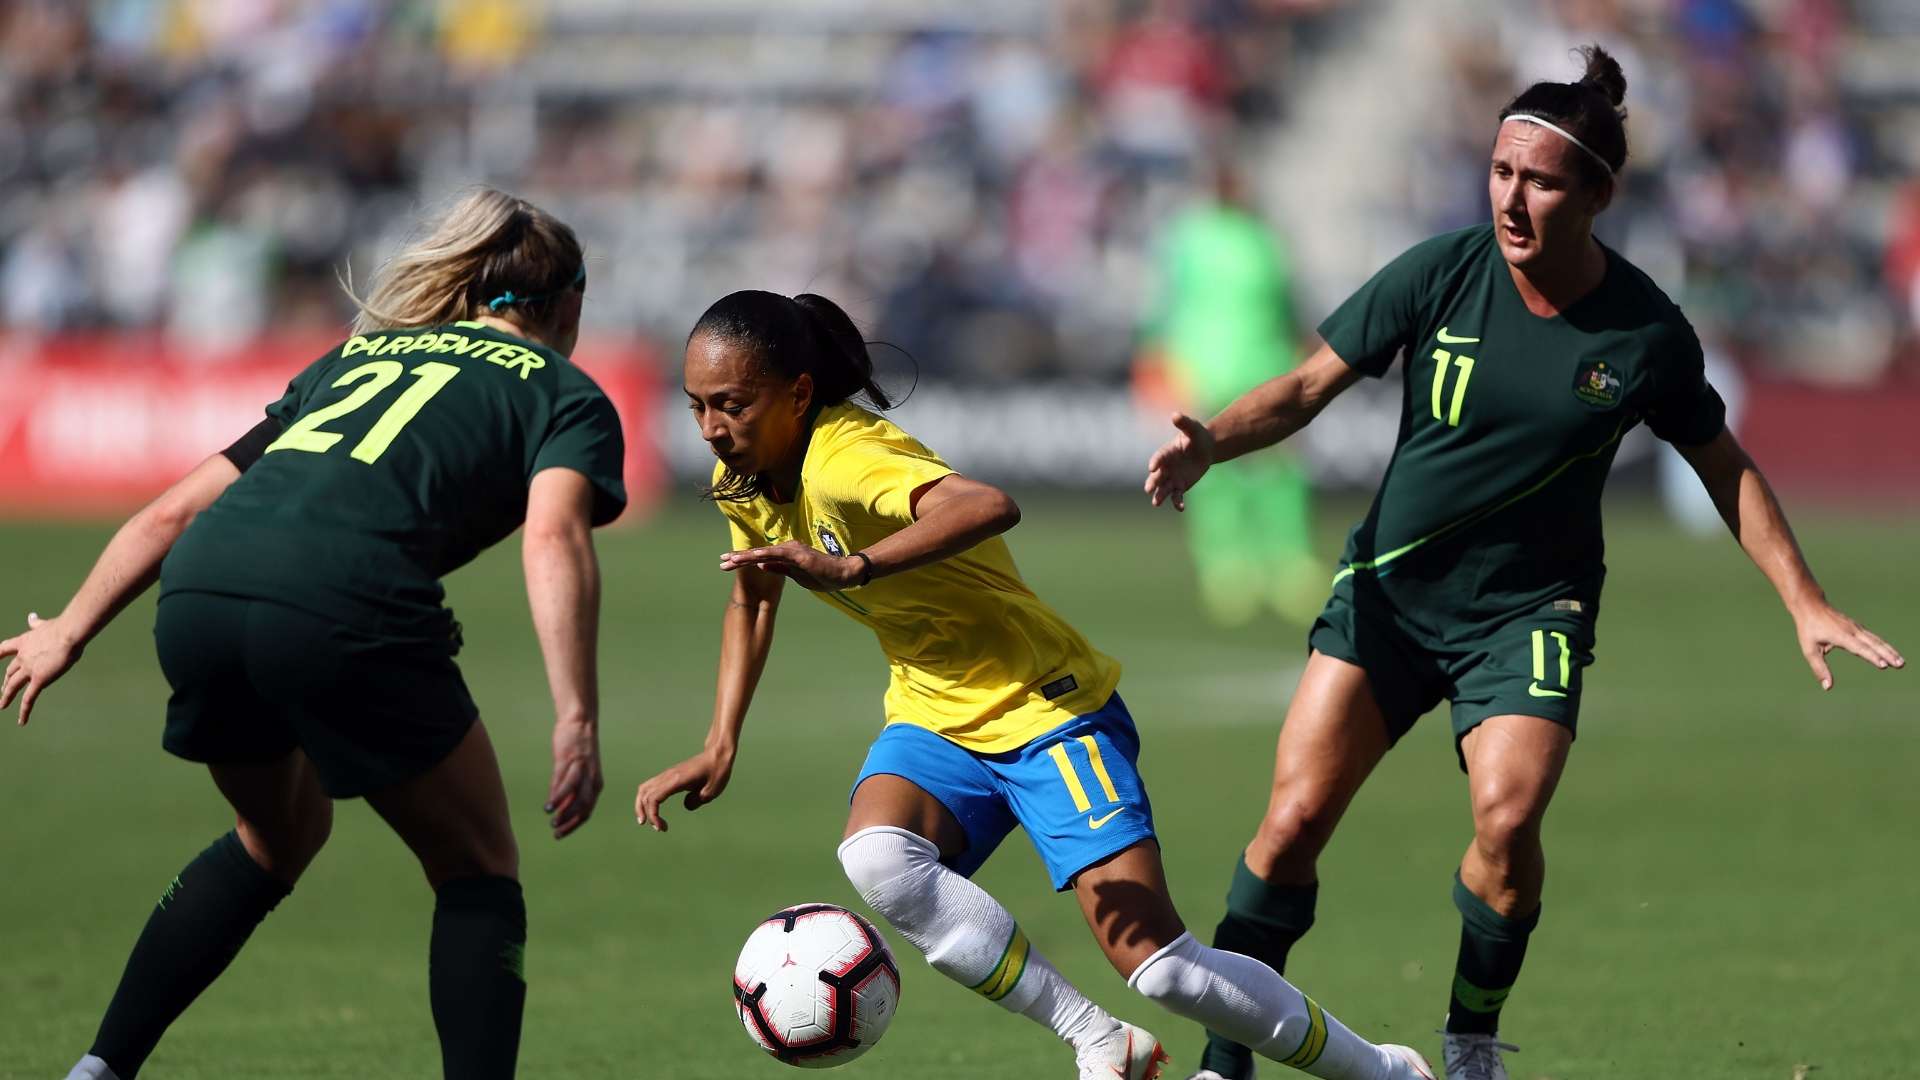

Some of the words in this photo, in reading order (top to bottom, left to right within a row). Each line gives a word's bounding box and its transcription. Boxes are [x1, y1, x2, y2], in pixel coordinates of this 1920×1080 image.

[264, 360, 461, 465] 21
[1431, 348, 1475, 427] 11
[1531, 629, 1570, 689] 11
[1047, 735, 1120, 813] 11
